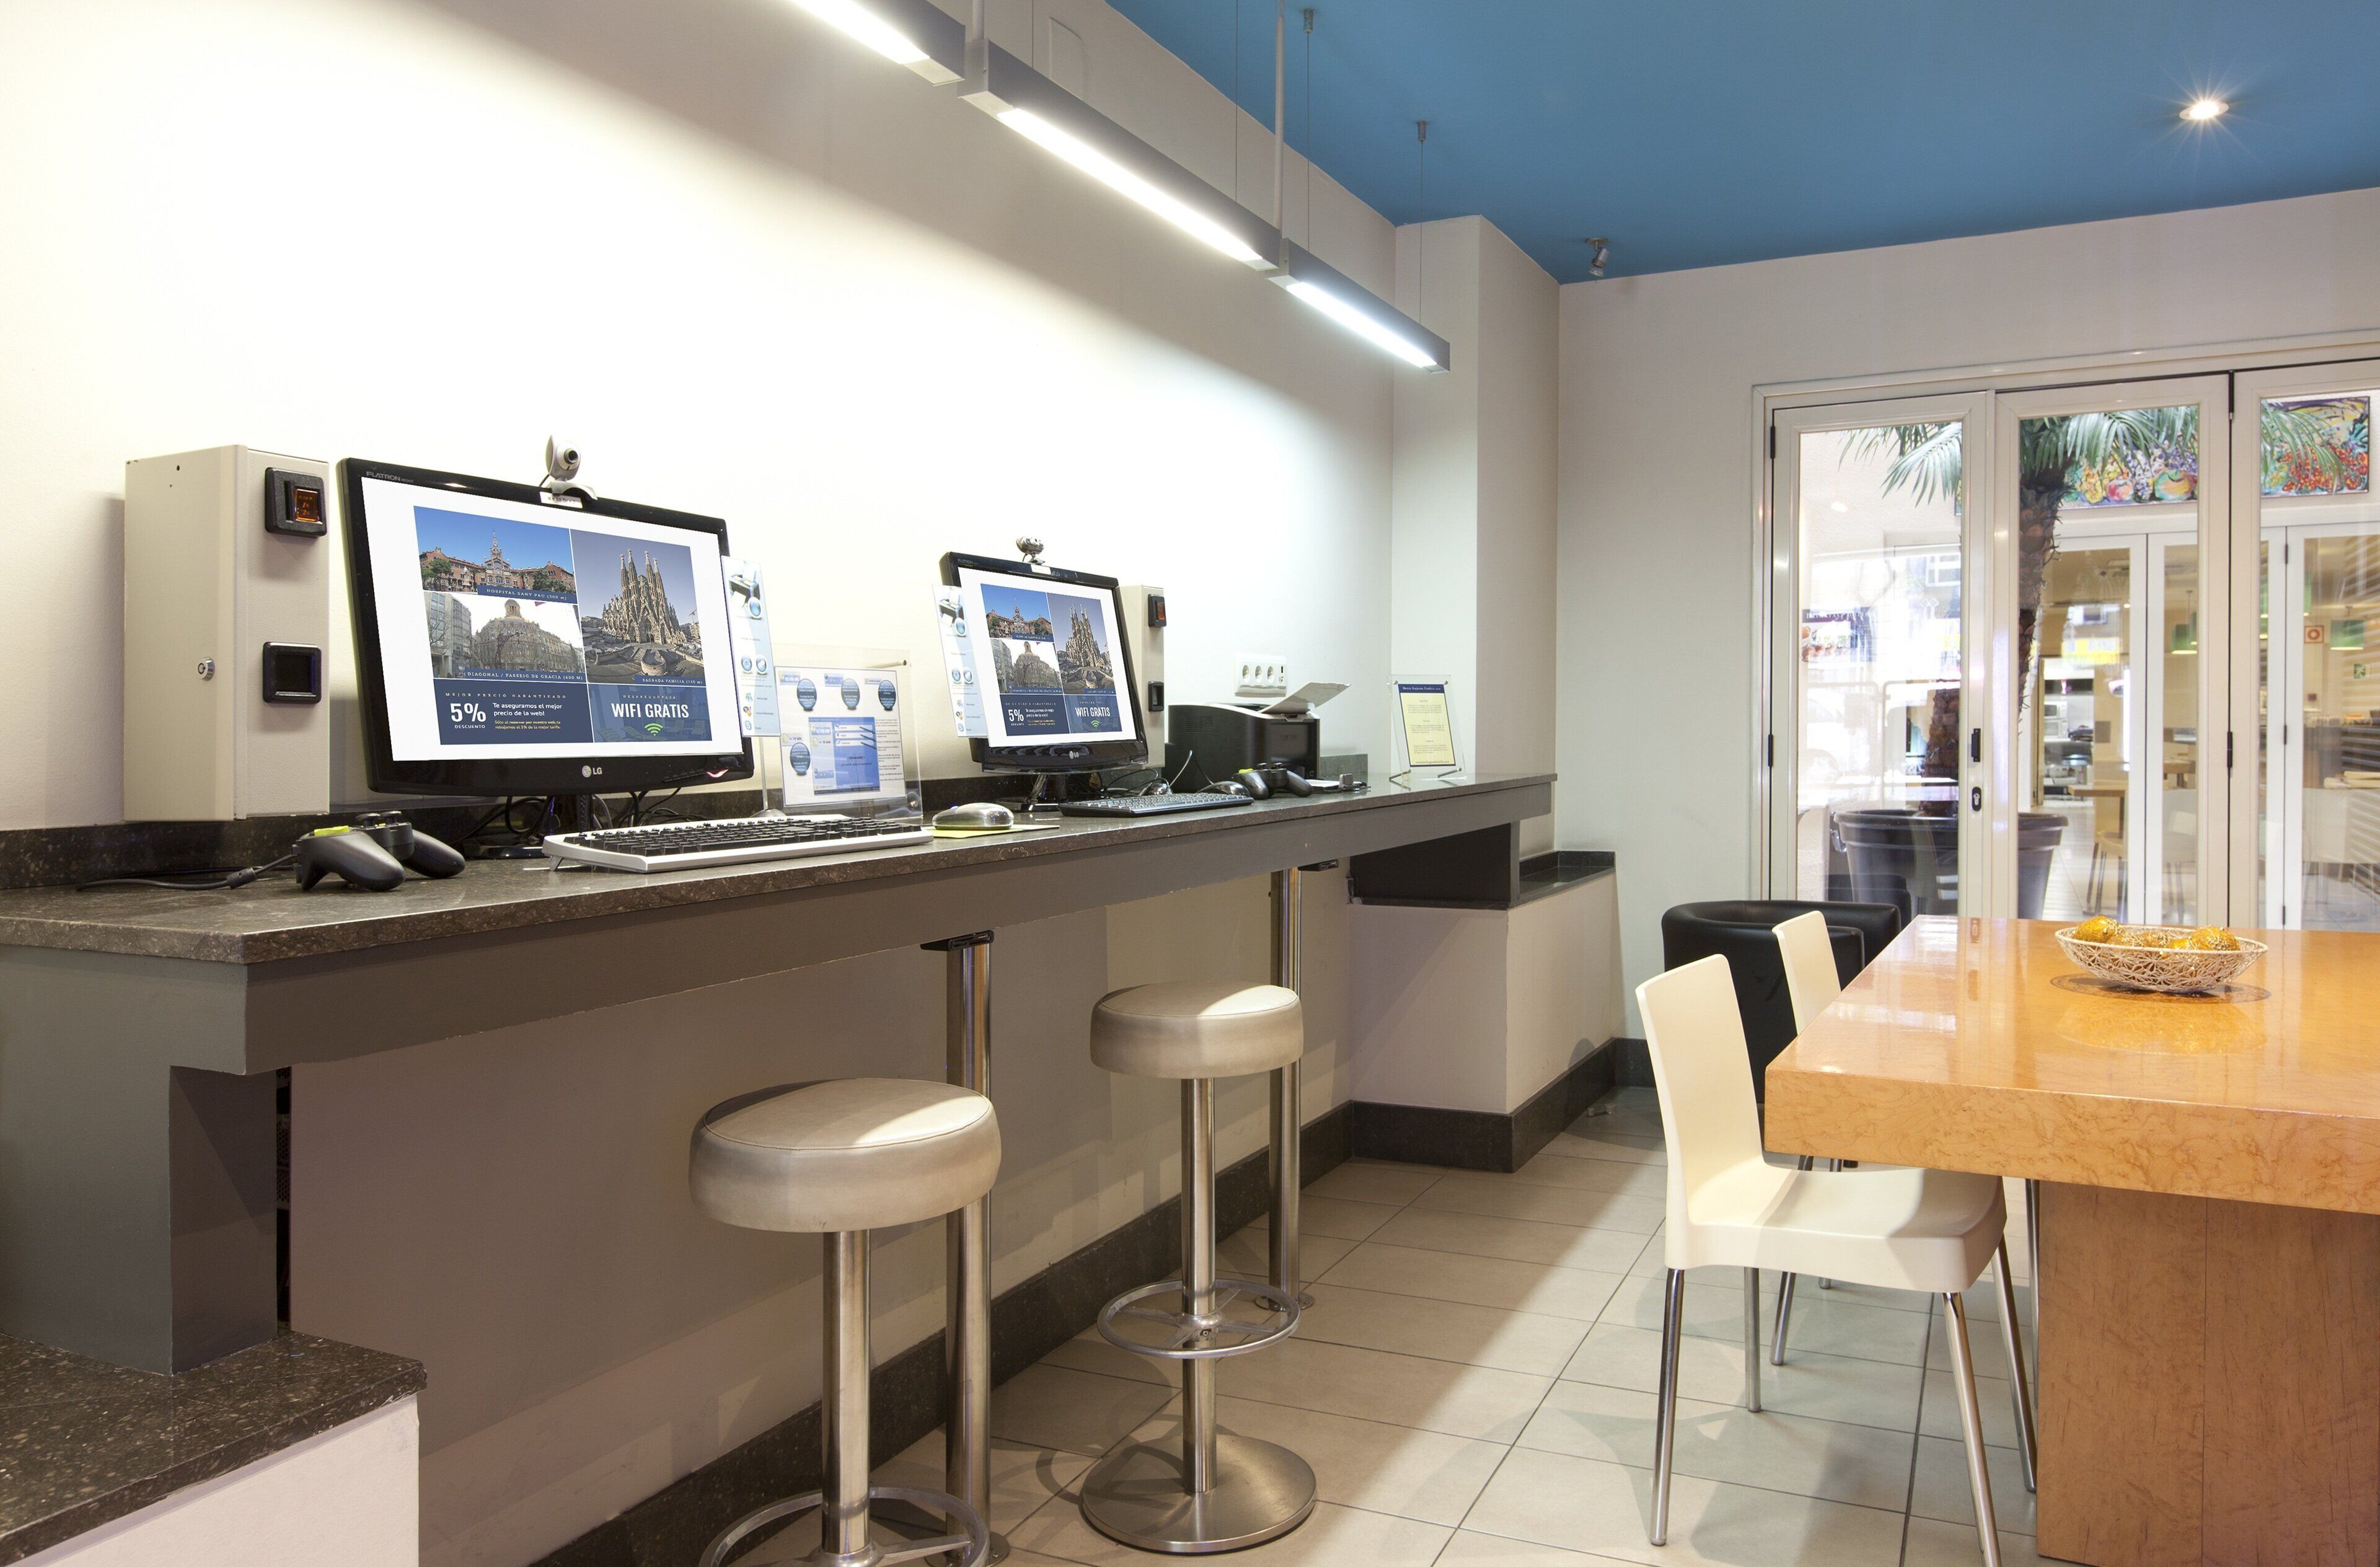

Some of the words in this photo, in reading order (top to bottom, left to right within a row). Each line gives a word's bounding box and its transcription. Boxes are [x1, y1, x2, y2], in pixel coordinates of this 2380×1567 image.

[366, 471, 400, 481] FLATRON
[450, 703, 487, 722] 5%
[610, 703, 641, 718] WIFI
[645, 704, 689, 718] GRATIS
[1008, 709, 1024, 722] 5%
[1075, 707, 1089, 717] WIFI
[1090, 707, 1111, 717] GRATIS
